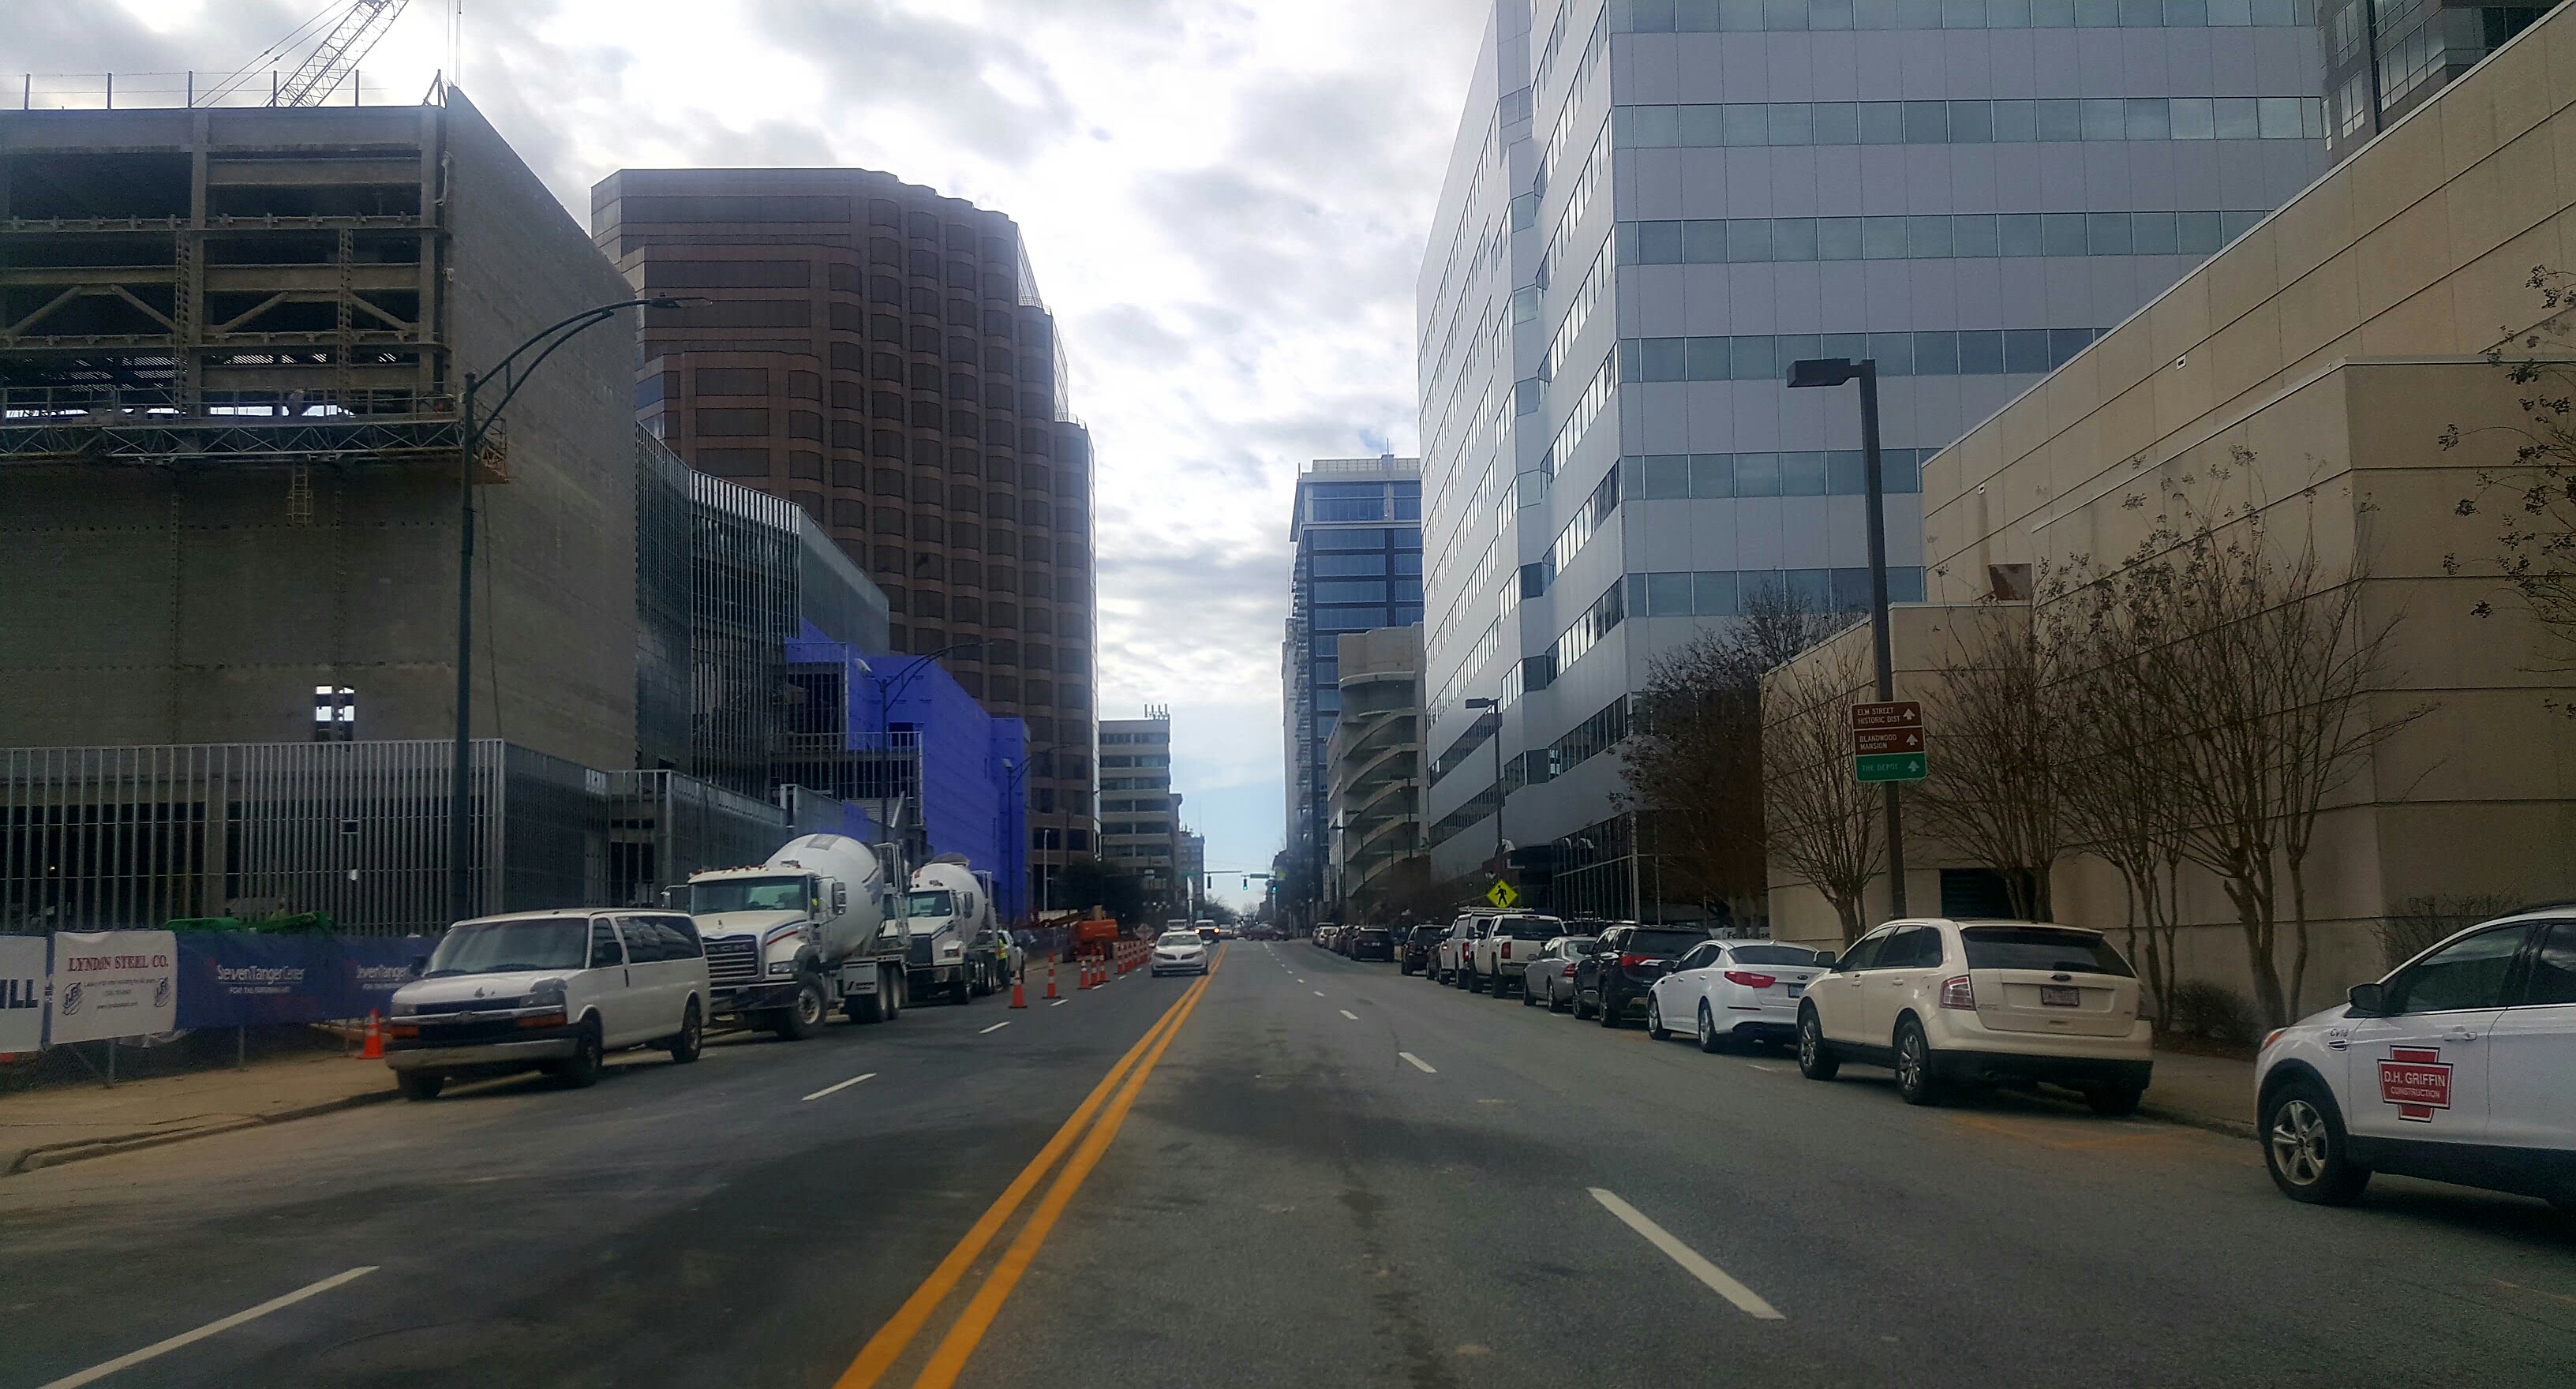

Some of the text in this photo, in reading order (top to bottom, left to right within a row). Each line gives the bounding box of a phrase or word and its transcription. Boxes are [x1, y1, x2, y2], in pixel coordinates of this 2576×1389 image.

[1872, 706, 1894, 715] STREET
[1858, 716, 1885, 724] HISTORIC
[1859, 734, 1897, 743] BLANDWOOD
[1860, 742, 1888, 751] MANSION
[68, 954, 169, 972] LYNDON STEEL CO.
[2383, 1070, 2446, 1087] D.H. GRIFFIN
[2391, 1086, 2440, 1099] CONSTRUCTION
